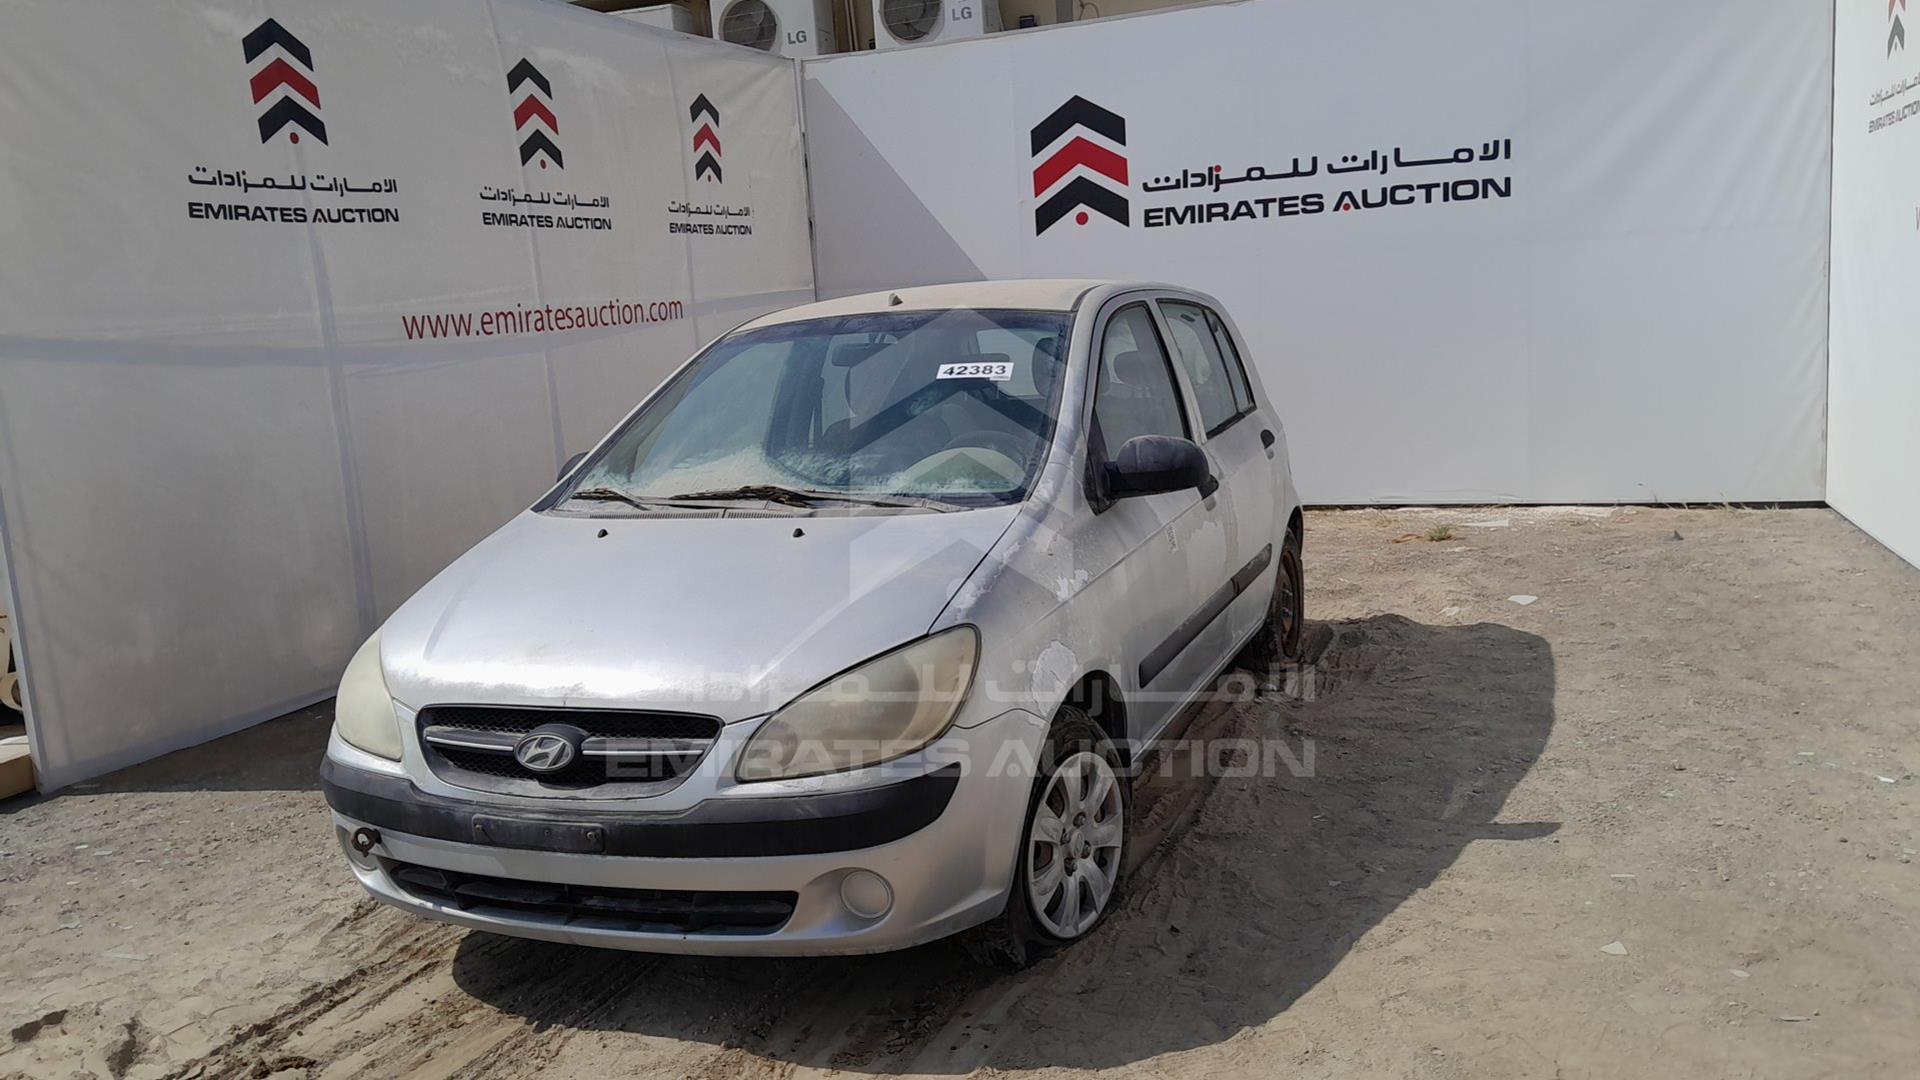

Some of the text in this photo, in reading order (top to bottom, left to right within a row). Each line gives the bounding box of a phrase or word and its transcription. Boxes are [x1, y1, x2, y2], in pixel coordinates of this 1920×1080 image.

[952, 7, 972, 21] LG
[787, 30, 807, 45] LG
[188, 165, 306, 193] للمزادات
[1142, 155, 1318, 193] للمزادات
[1143, 177, 1512, 228] EMIRATES AUCTION
[188, 202, 400, 224] EMIRATES AUCTION
[482, 212, 612, 230] EMIRATES AUCTION
[669, 222, 752, 235] EMIRATES AUCTION
[401, 298, 685, 340] www.emiratesauction.com
[942, 365, 1007, 376] 42383
